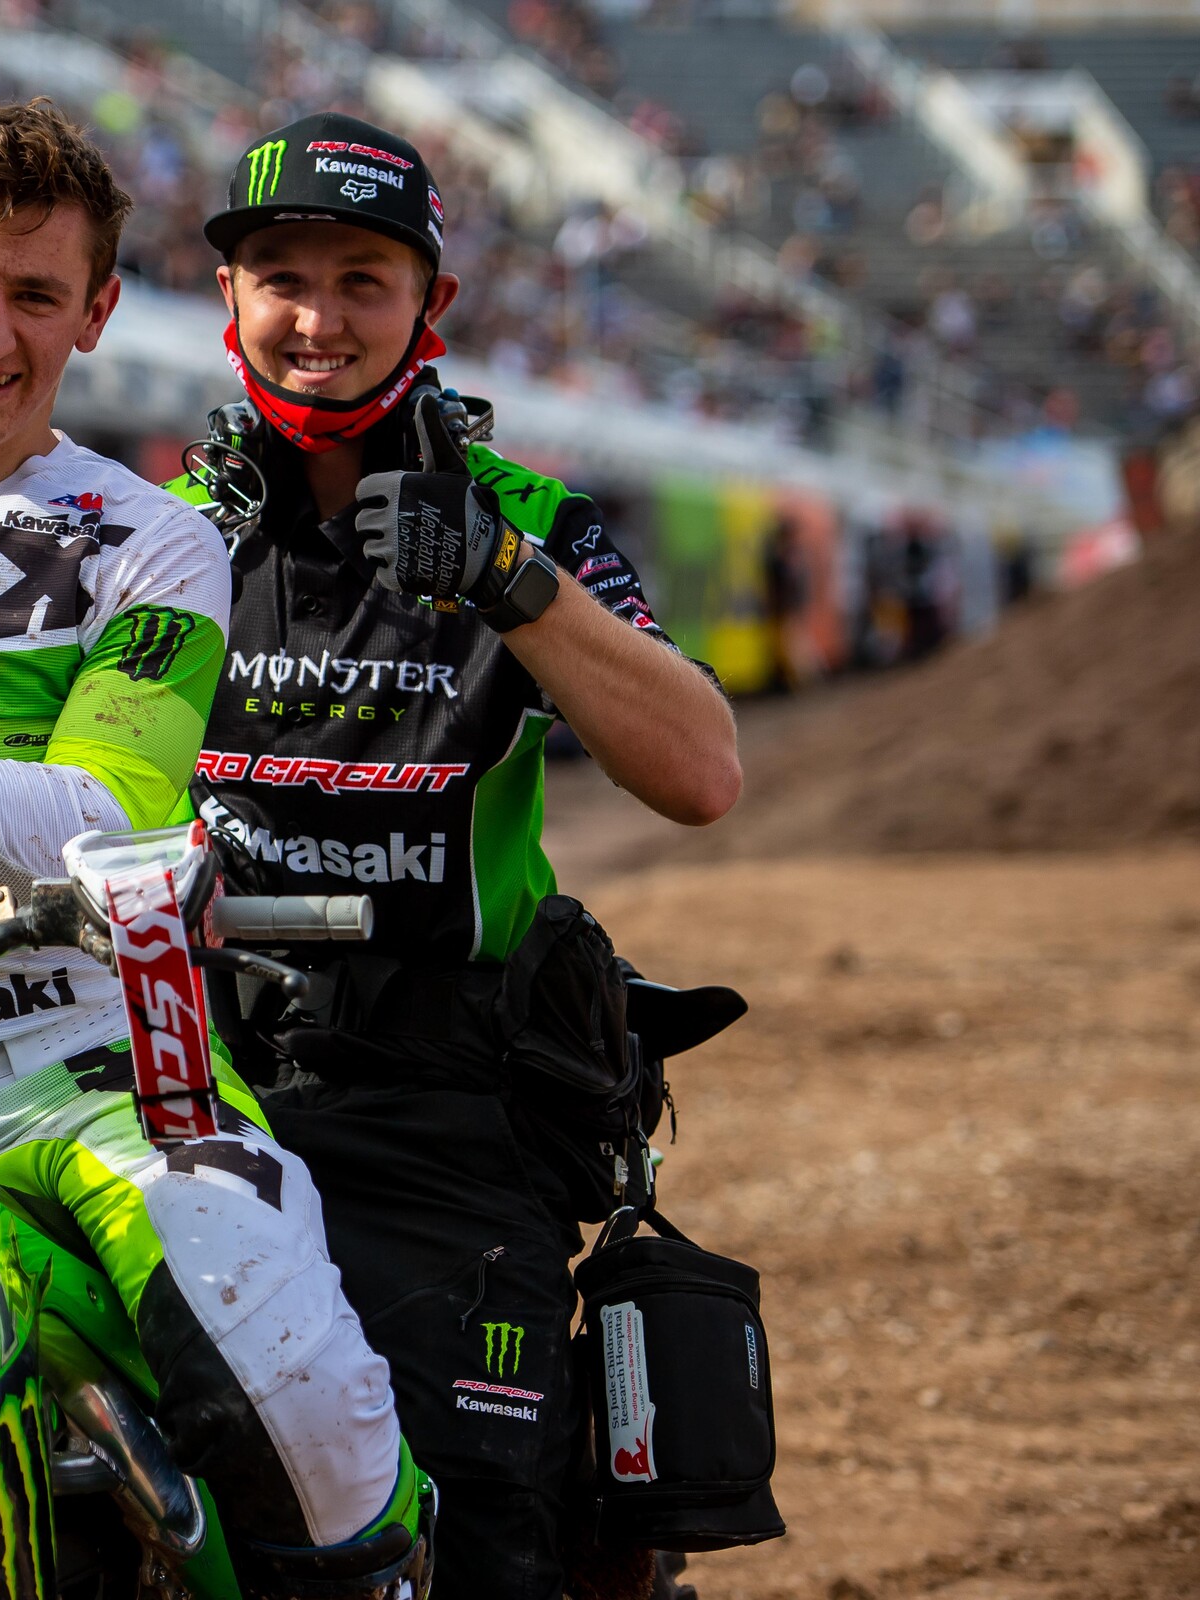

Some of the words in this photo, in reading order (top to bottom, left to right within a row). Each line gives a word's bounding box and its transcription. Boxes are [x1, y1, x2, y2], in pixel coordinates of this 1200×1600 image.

[306, 141, 349, 153] PRO
[348, 143, 415, 170] CIRCUIT
[315, 157, 404, 190] Kawasaki
[416, 501, 442, 581] Mechanix
[228, 647, 458, 699] MONSTER
[245, 698, 406, 721] ENERGY
[195, 750, 251, 783] RO
[251, 755, 471, 795] CIRCUIT
[199, 795, 446, 883] Kawasaki
[605, 1312, 617, 1380] Children's
[614, 1310, 625, 1366] Hospital
[452, 1379, 488, 1391] PRO
[486, 1384, 544, 1402] CIRCUIT
[608, 1383, 620, 1411] Jude
[616, 1367, 629, 1427] Research
[631, 1392, 639, 1421] Finding
[456, 1395, 537, 1422] Kawasaki
[611, 1411, 620, 1429] St.
